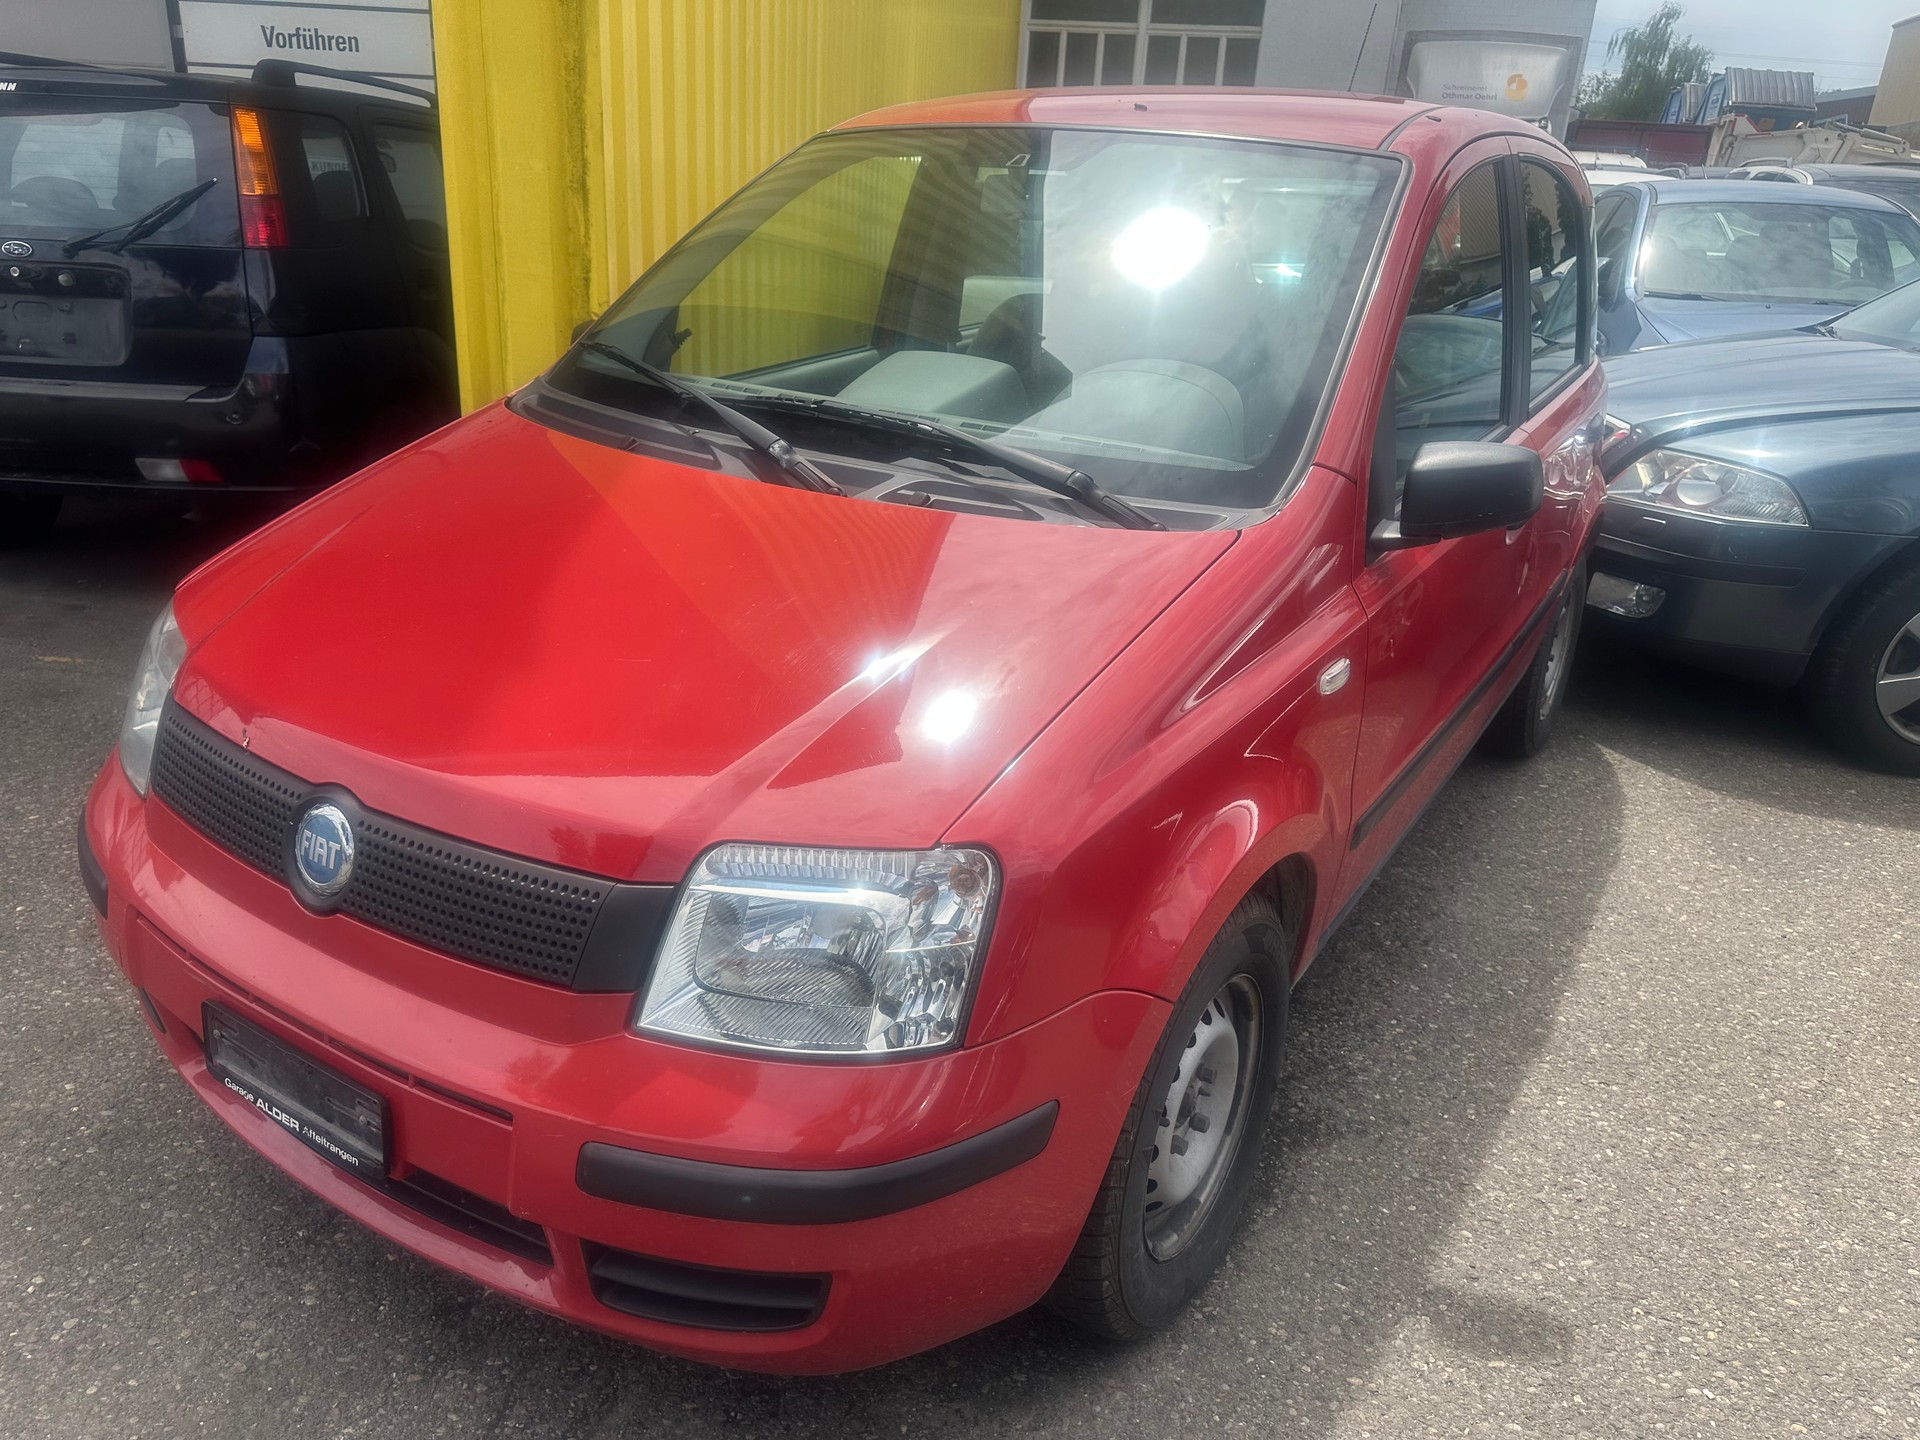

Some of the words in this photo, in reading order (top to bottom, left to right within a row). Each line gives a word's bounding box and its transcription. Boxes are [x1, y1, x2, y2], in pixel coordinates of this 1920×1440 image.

[260, 24, 360, 53] Vorführen
[300, 829, 341, 870] FIAT
[224, 1077, 255, 1102] Garage
[256, 1097, 300, 1132] ALDER
